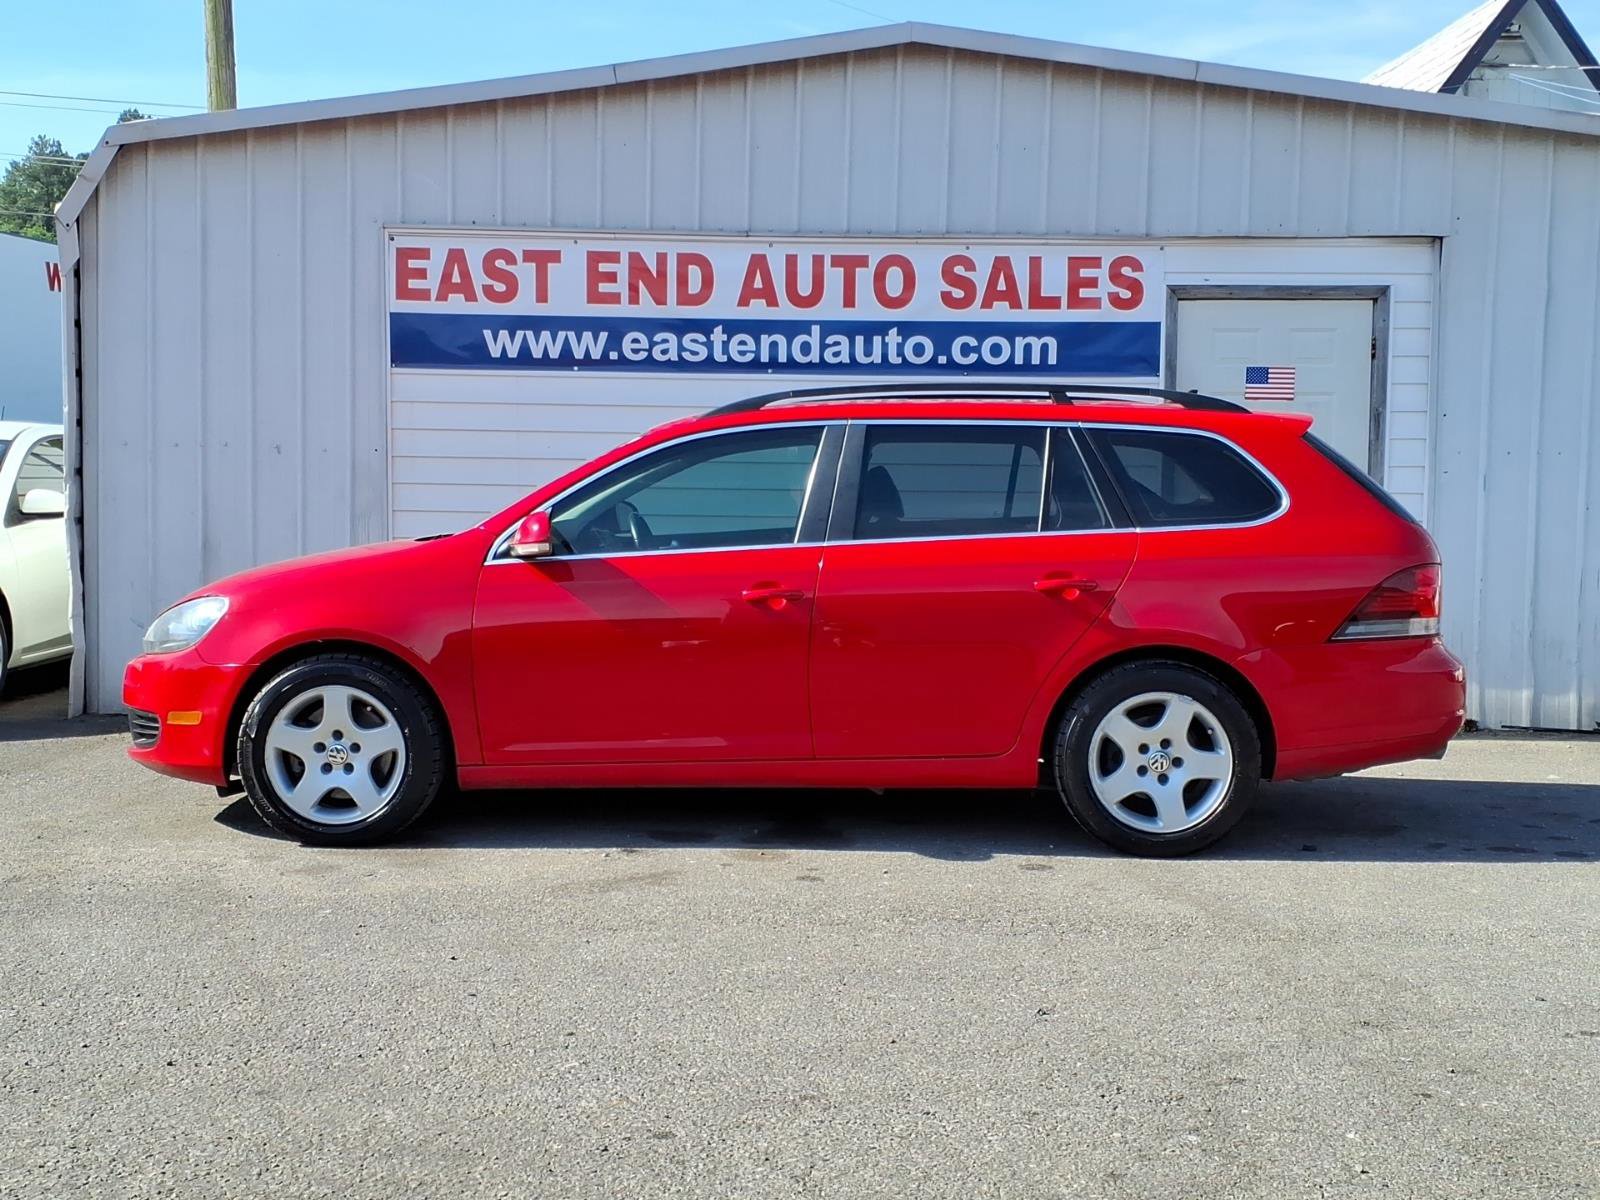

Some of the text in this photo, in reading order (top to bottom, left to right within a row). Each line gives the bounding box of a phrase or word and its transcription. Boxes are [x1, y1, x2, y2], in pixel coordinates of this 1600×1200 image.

[395, 247, 1146, 312] EAST END AUTO SALES
[482, 323, 1060, 366] www.eastendauto.com
